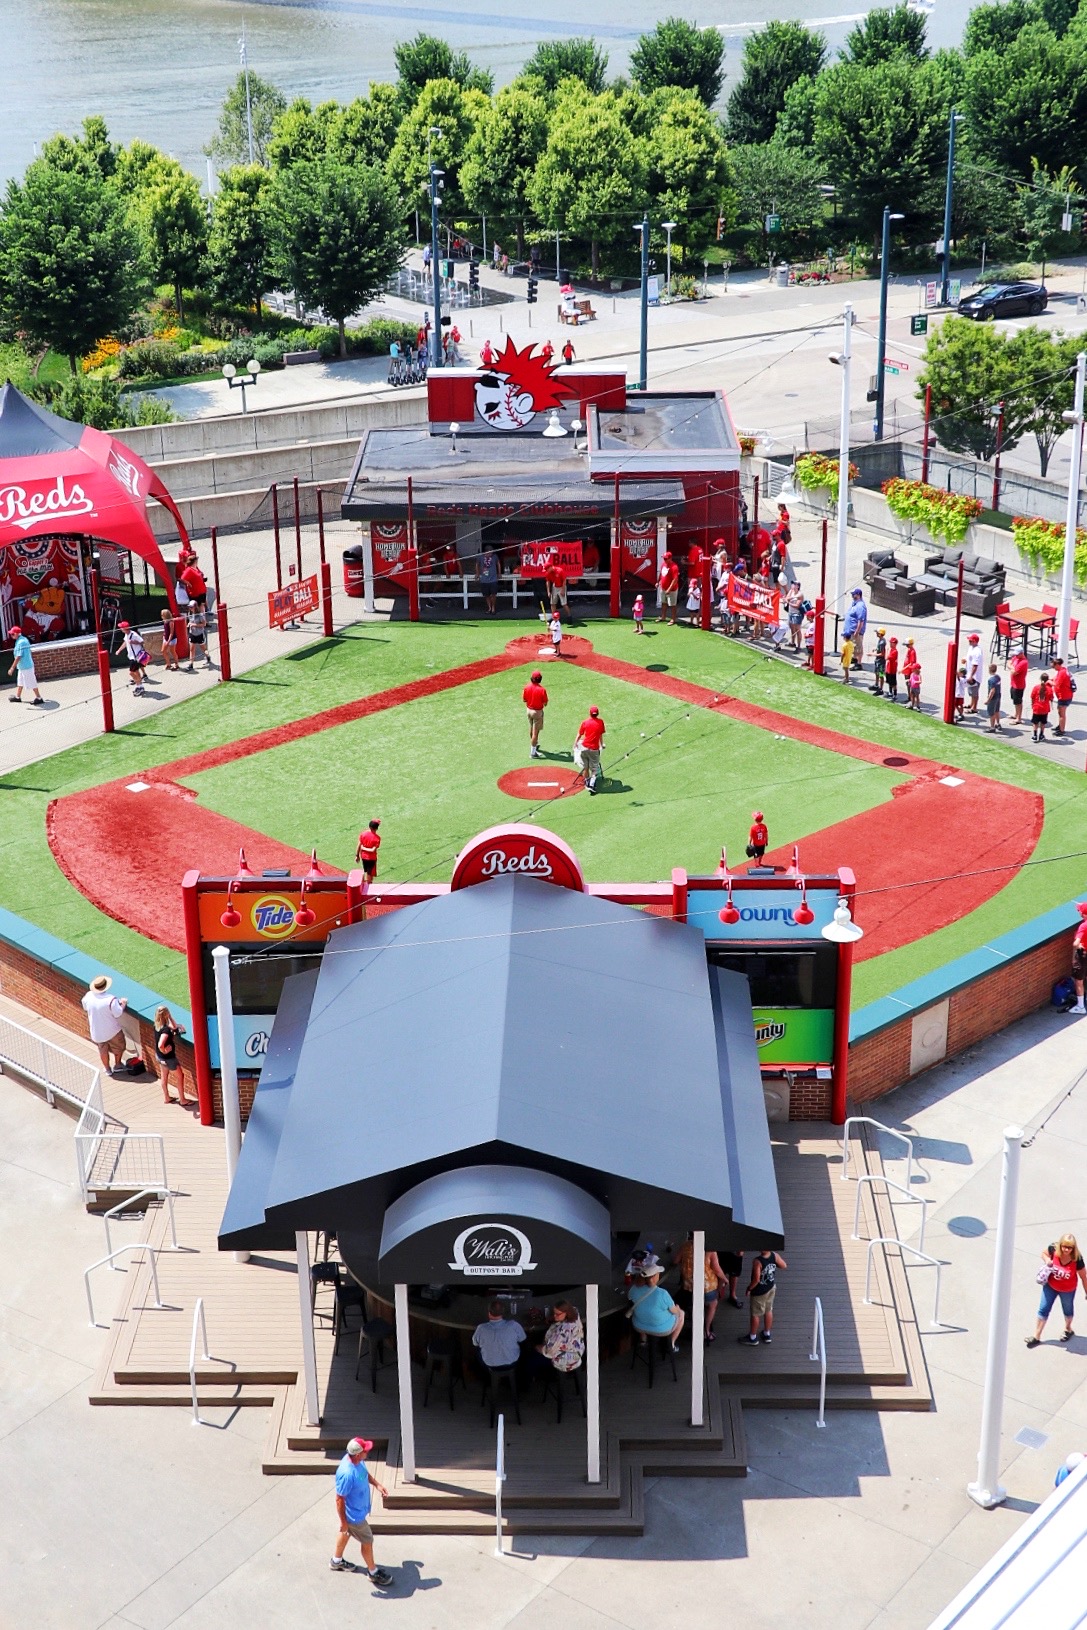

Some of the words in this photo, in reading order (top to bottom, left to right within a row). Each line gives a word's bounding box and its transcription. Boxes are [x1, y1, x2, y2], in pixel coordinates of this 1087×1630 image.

[0, 475, 94, 530] Reds
[520, 503, 600, 516] Clubhouse
[522, 553, 550, 567] PLAY
[553, 553, 581, 566] BALL
[293, 585, 313, 605] BALL
[481, 846, 552, 877] Reds
[255, 905, 294, 931] Tide
[723, 905, 799, 927] owny
[466, 1238, 519, 1259] Walt's
